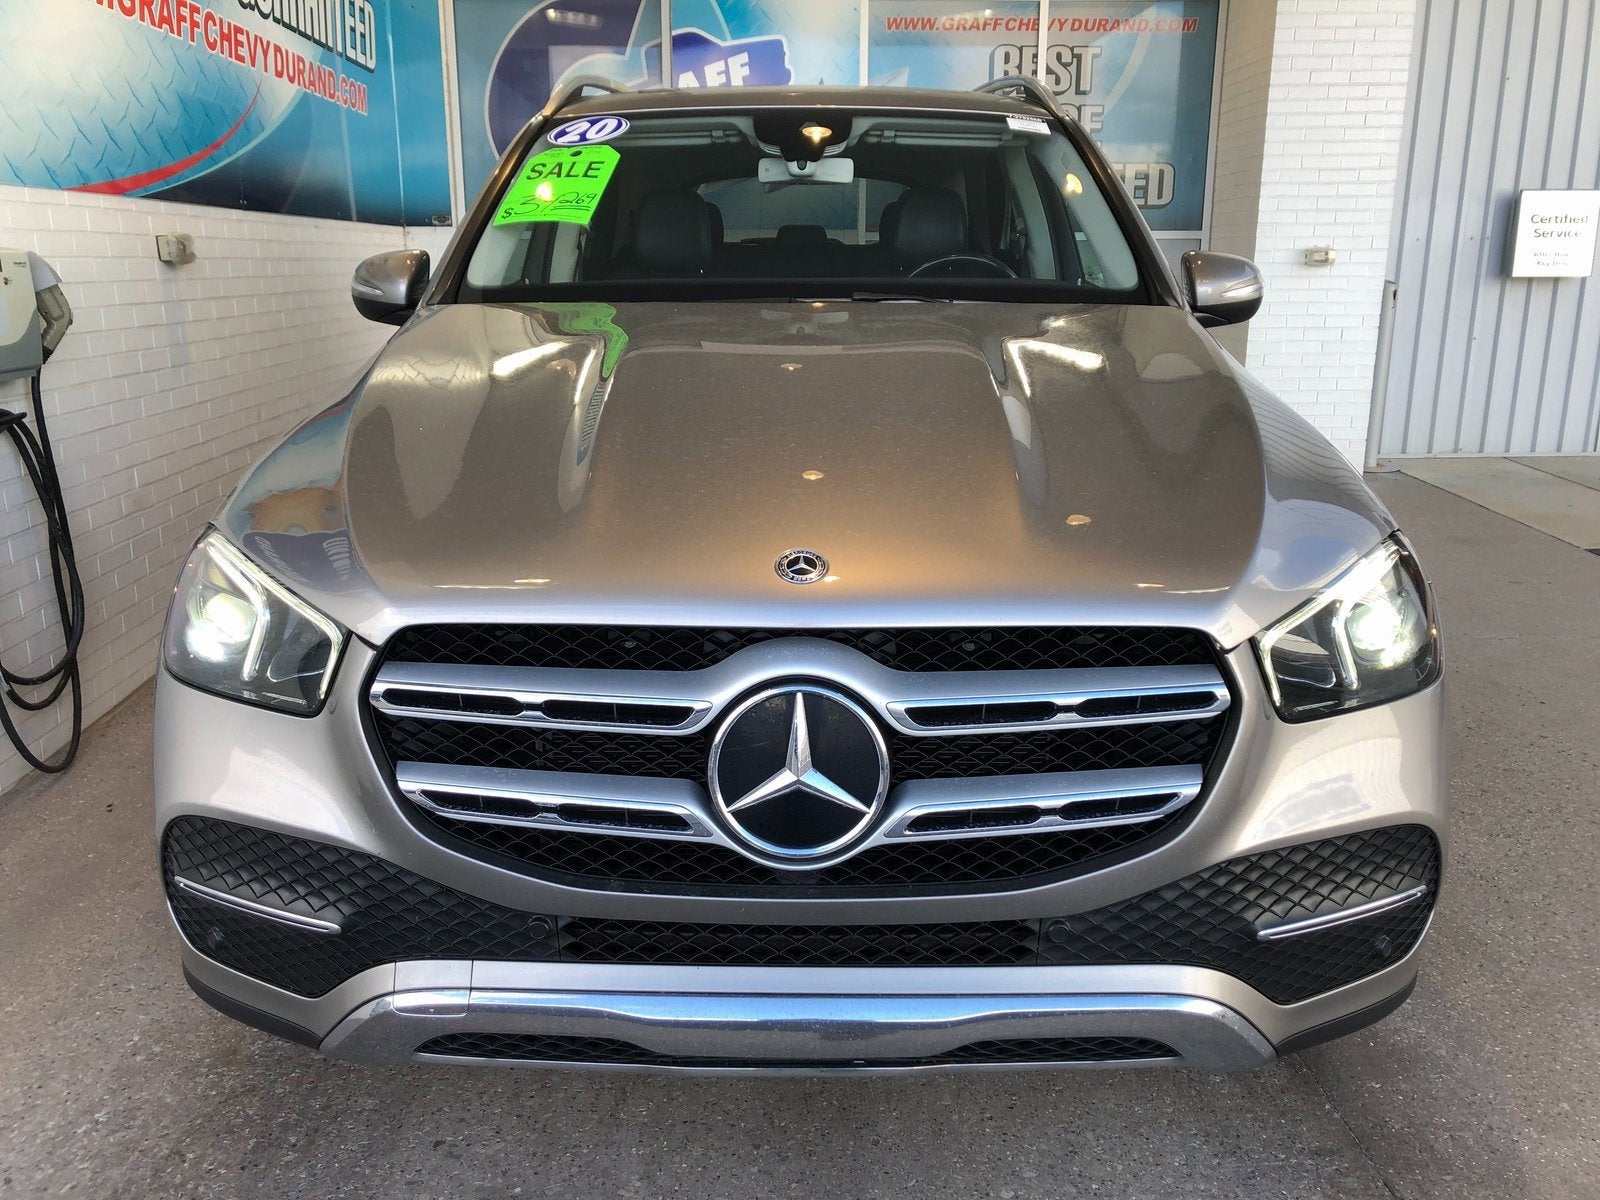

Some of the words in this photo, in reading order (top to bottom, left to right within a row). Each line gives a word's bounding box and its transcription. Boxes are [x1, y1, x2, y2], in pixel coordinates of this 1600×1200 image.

[556, 118, 619, 143] 20
[526, 161, 605, 180] SALE
[1530, 213, 1589, 224] Certified
[1533, 228, 1582, 238] Service
